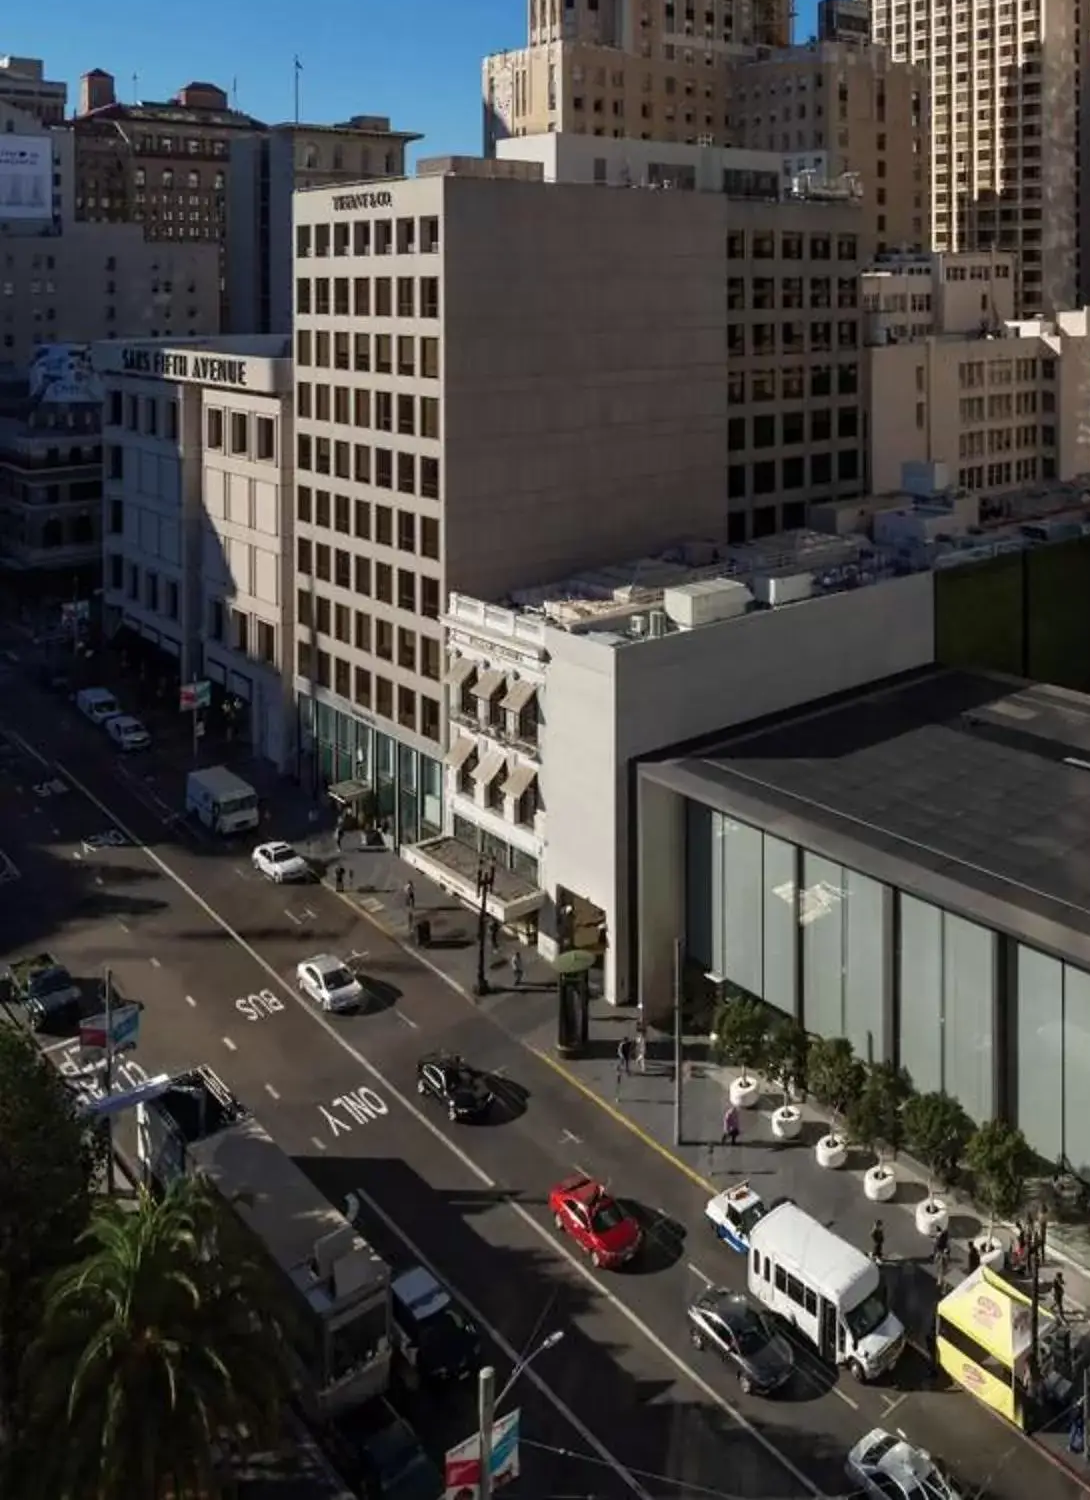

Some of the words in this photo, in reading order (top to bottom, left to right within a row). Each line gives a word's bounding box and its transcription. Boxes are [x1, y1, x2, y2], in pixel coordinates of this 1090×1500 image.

[121, 348, 150, 371] SAKS
[154, 351, 188, 377] FIFTH
[191, 356, 247, 386] AVENUE
[235, 987, 285, 1021] BUS
[317, 1086, 390, 1138] ONLY
